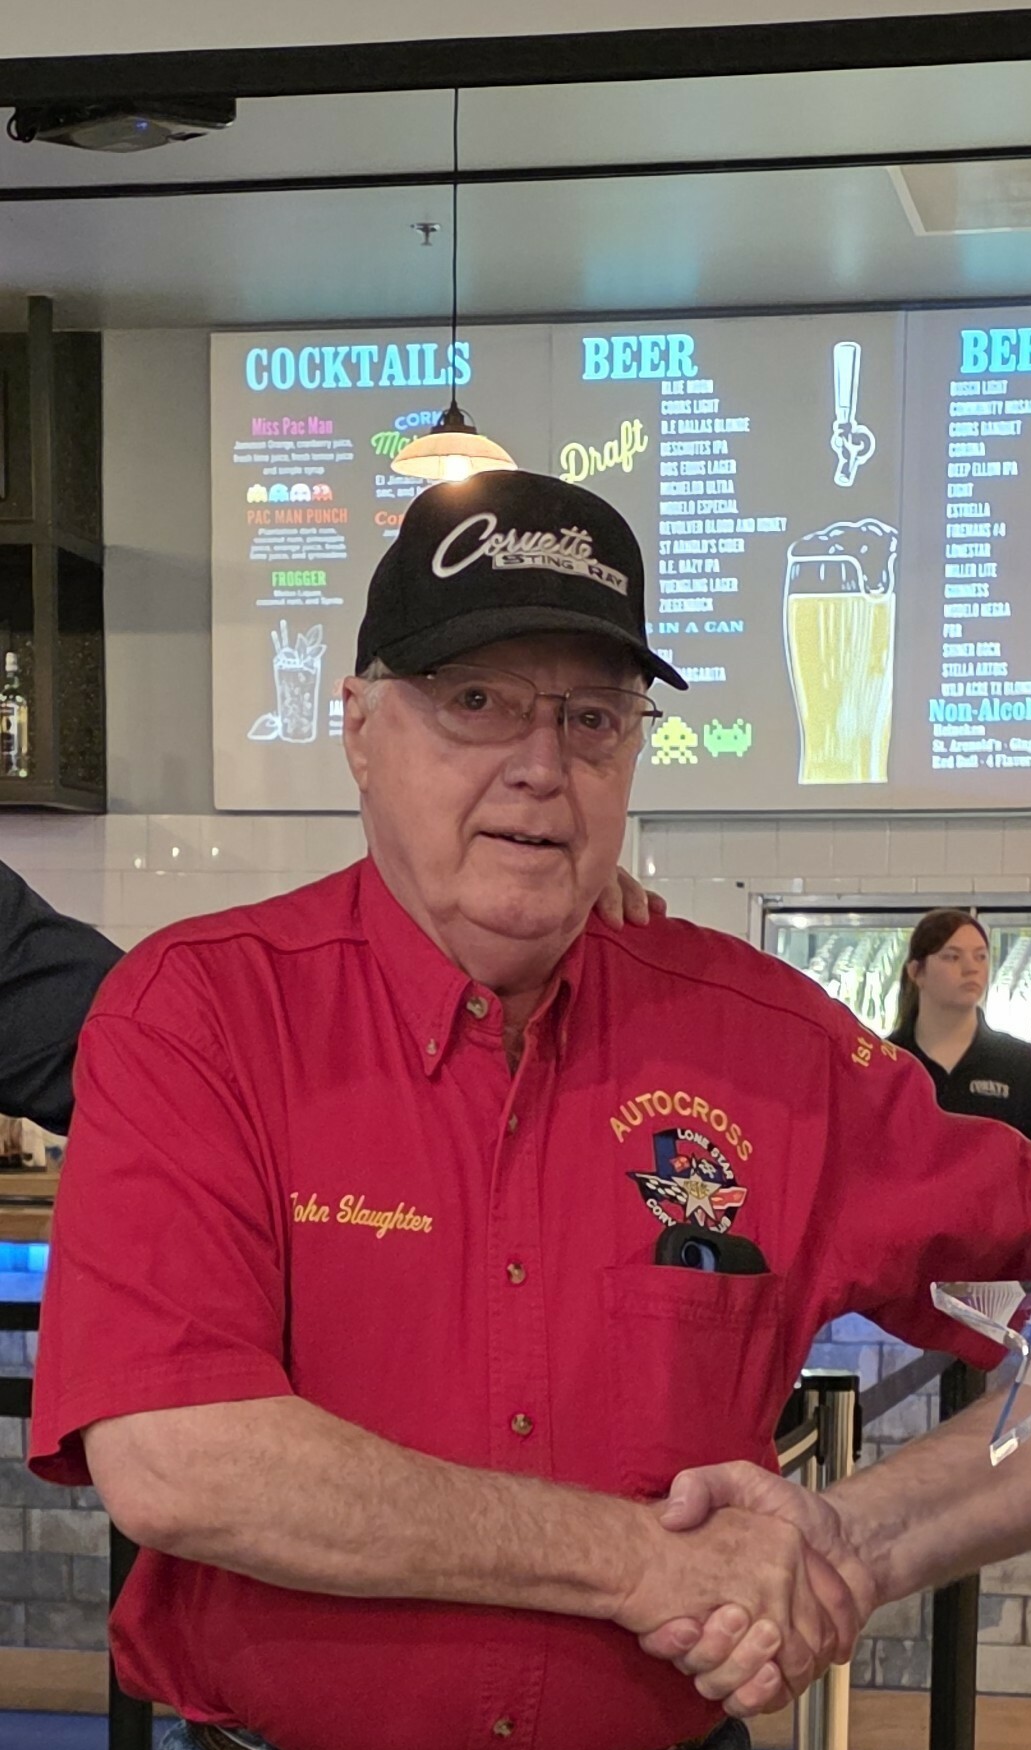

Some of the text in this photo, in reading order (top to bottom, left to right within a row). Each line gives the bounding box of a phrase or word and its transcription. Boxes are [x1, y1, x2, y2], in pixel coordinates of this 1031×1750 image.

[245, 341, 472, 391] COCKTAILS
[582, 333, 698, 380] BEER
[252, 416, 333, 436] Miss Pac Man
[394, 411, 446, 431] CORK
[559, 418, 648, 484] Draft
[247, 508, 348, 525] PAC MAN PUNCH
[431, 511, 598, 579] Corvette
[272, 570, 327, 587] FROGGER
[502, 554, 623, 587] STING RAY
[659, 622, 679, 634] IN
[685, 622, 699, 633] A
[704, 621, 744, 633] CAN
[851, 1036, 874, 1067] 1st
[609, 1090, 753, 1162] AUTOCROSS
[677, 1128, 735, 1180] LONE STAR
[336, 1194, 433, 1239] Slaughter
[646, 1198, 677, 1227] CORV
